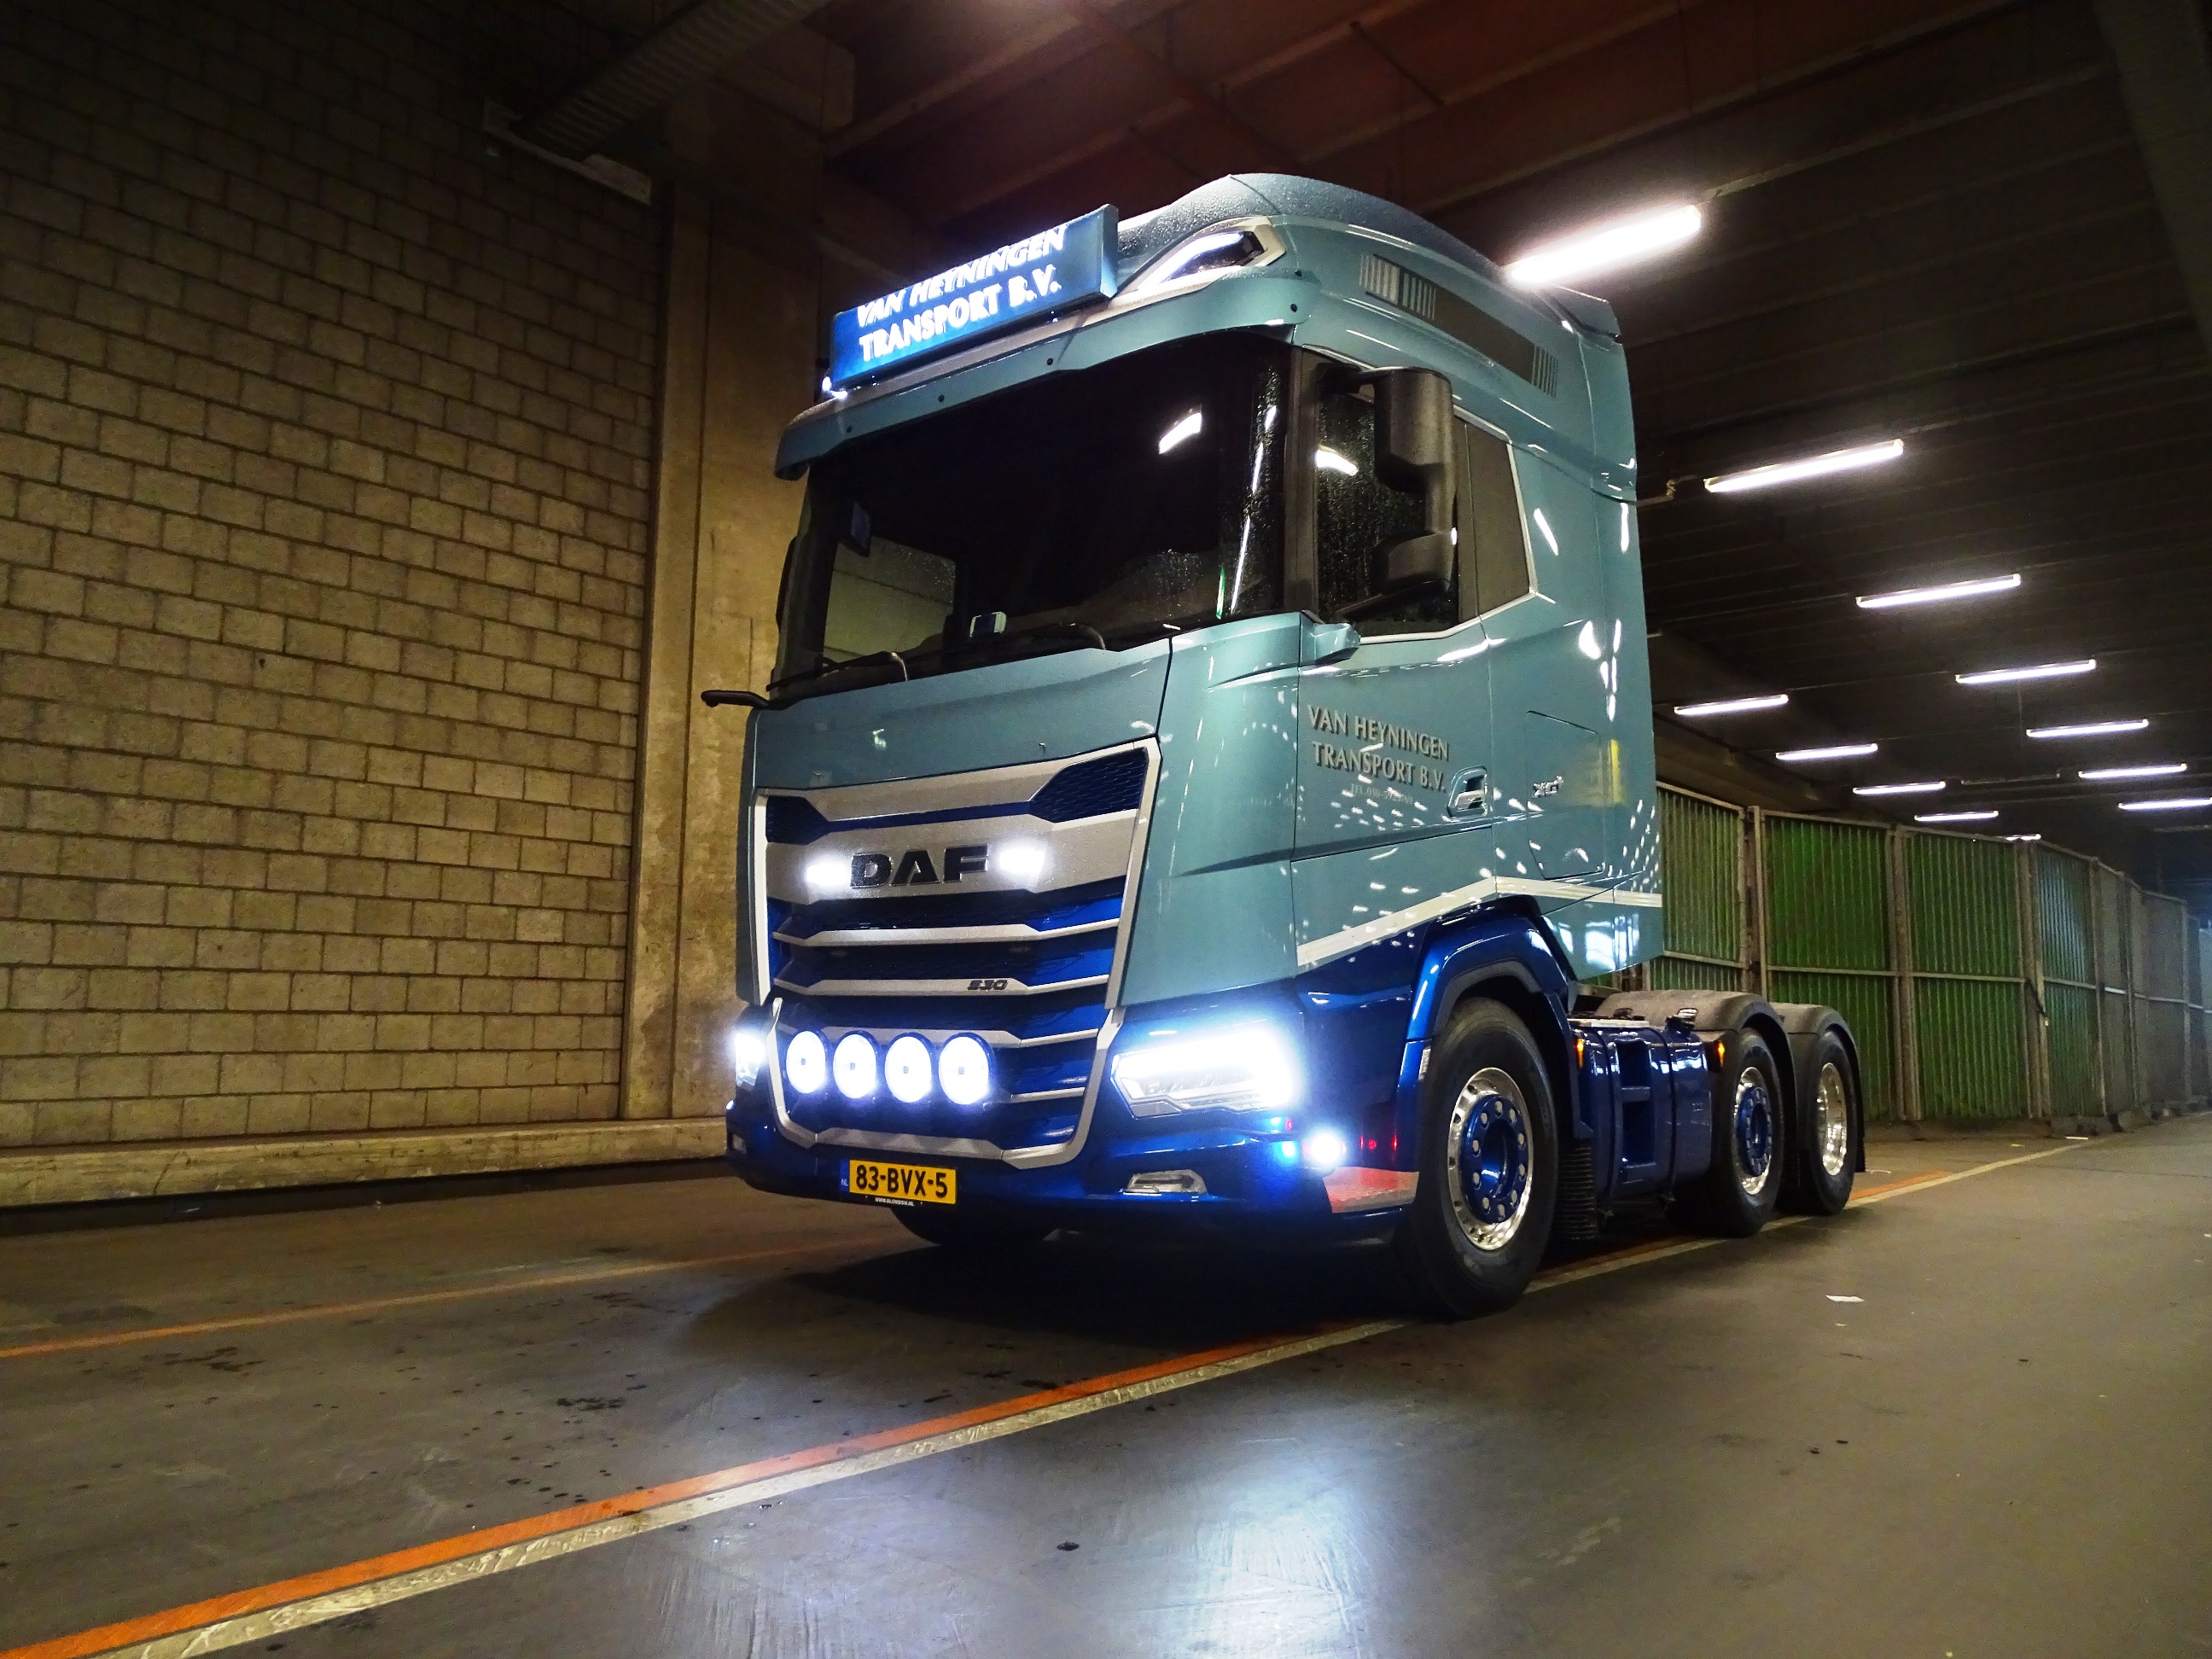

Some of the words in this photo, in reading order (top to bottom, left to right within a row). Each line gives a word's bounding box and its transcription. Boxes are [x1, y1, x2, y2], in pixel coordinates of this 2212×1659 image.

[857, 288, 907, 328] VAN
[909, 224, 1068, 308] HEYNINGEN
[859, 283, 1003, 362] TRANSPORT
[1008, 264, 1062, 308] B.V.
[1308, 704, 1348, 736] VAN
[1354, 715, 1449, 761] HEYNINGEN
[1313, 741, 1415, 785] TRANSPORT
[1419, 765, 1447, 793] B.V.
[851, 844, 987, 888] DAF
[841, 1178, 849, 1187] NL
[856, 1164, 948, 1198] 83-BVX-5
